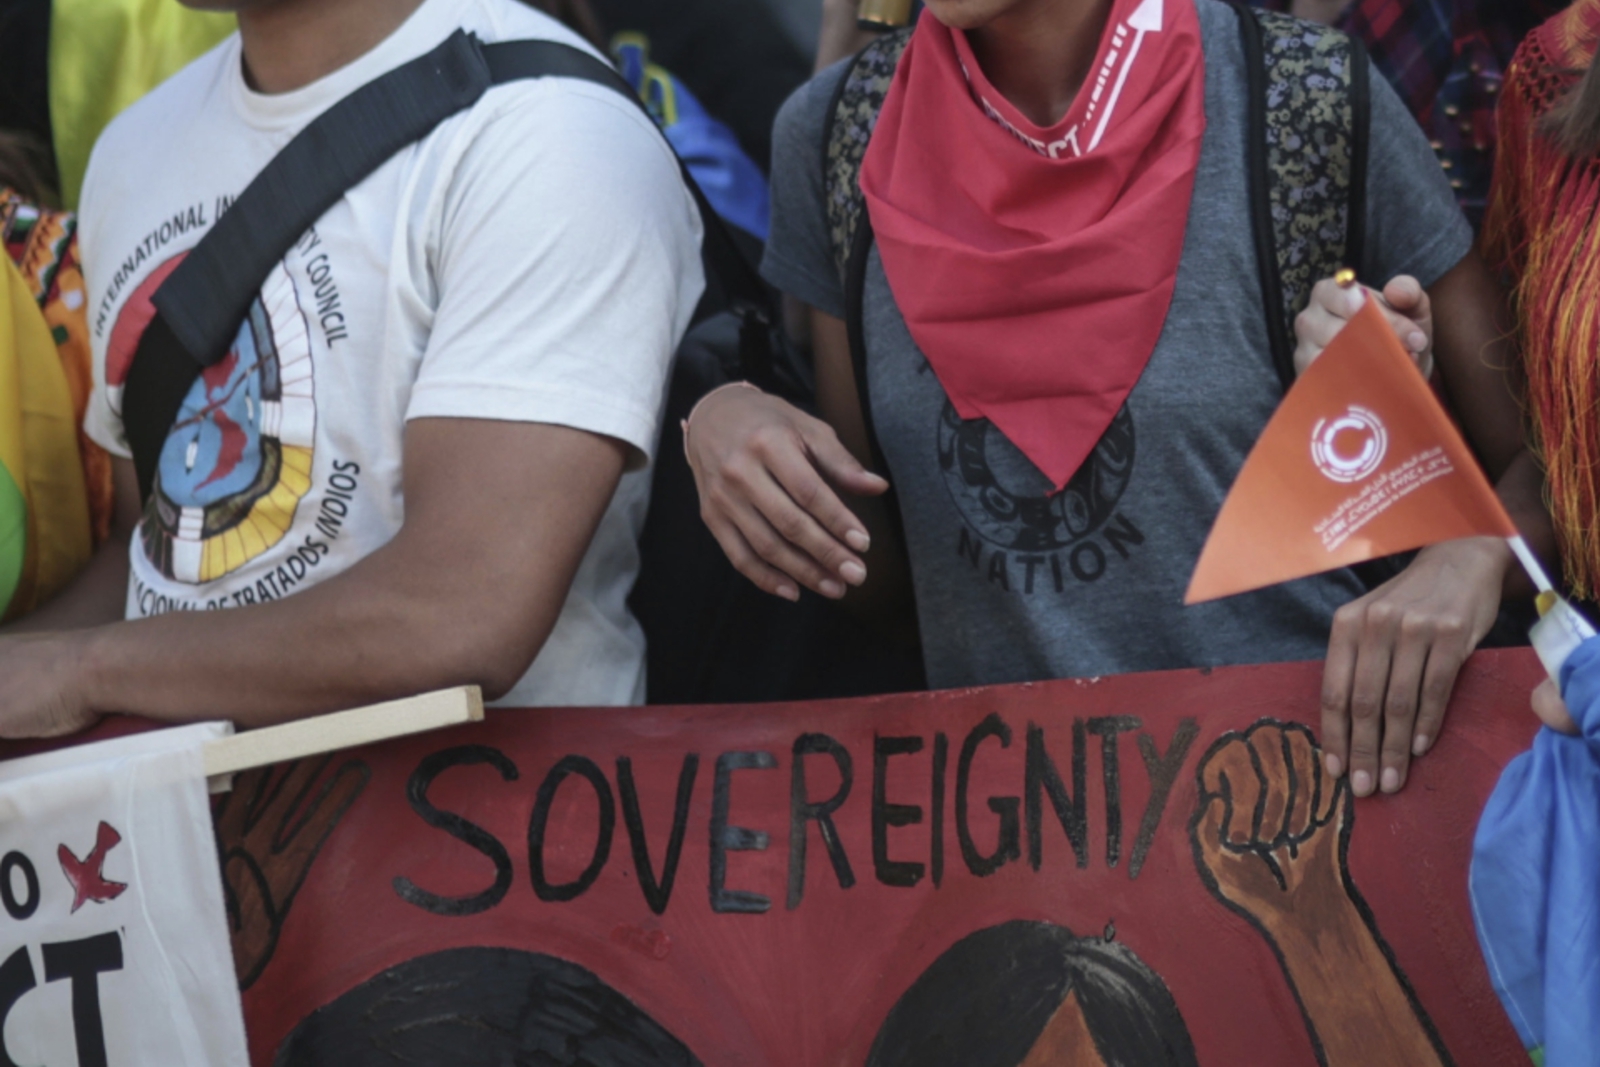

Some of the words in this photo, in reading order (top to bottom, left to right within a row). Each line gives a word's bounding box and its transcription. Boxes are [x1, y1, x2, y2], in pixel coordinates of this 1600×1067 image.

[95, 202, 207, 339] INTERNATIONAL
[306, 253, 348, 349] COUNCIL
[232, 536, 329, 606] TRATADOS
[315, 459, 361, 540] INDIOS
[957, 512, 1146, 595] NATION
[392, 713, 1198, 916] SOVEREIGNTY
